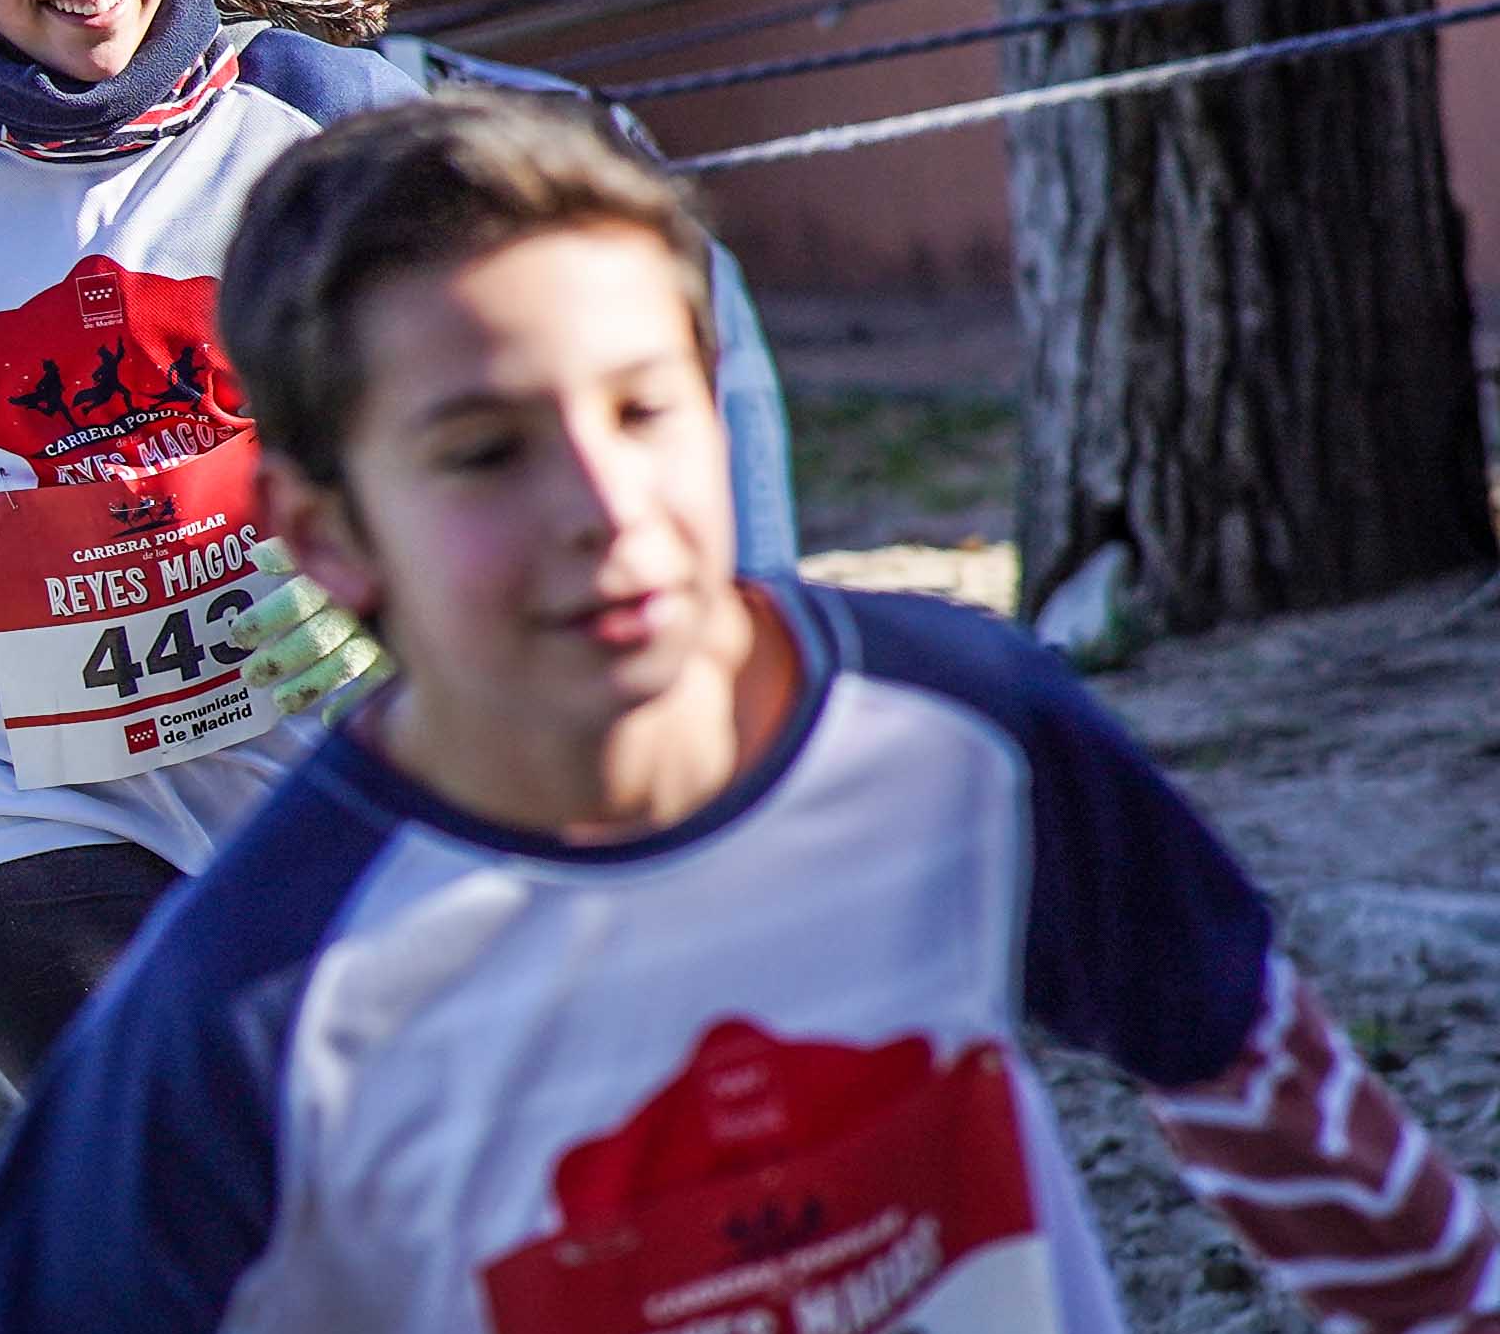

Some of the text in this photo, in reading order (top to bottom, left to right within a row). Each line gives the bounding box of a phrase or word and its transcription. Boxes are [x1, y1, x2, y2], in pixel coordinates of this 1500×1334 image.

[44, 409, 209, 456] CARRERA POPULAR
[72, 513, 226, 563] CARRERA POPULAR
[142, 548, 169, 561] de los
[45, 524, 259, 618] REYES MAGOS
[82, 589, 258, 698] 443
[160, 687, 249, 727] Comunidad
[163, 703, 252, 745] de Madrid
